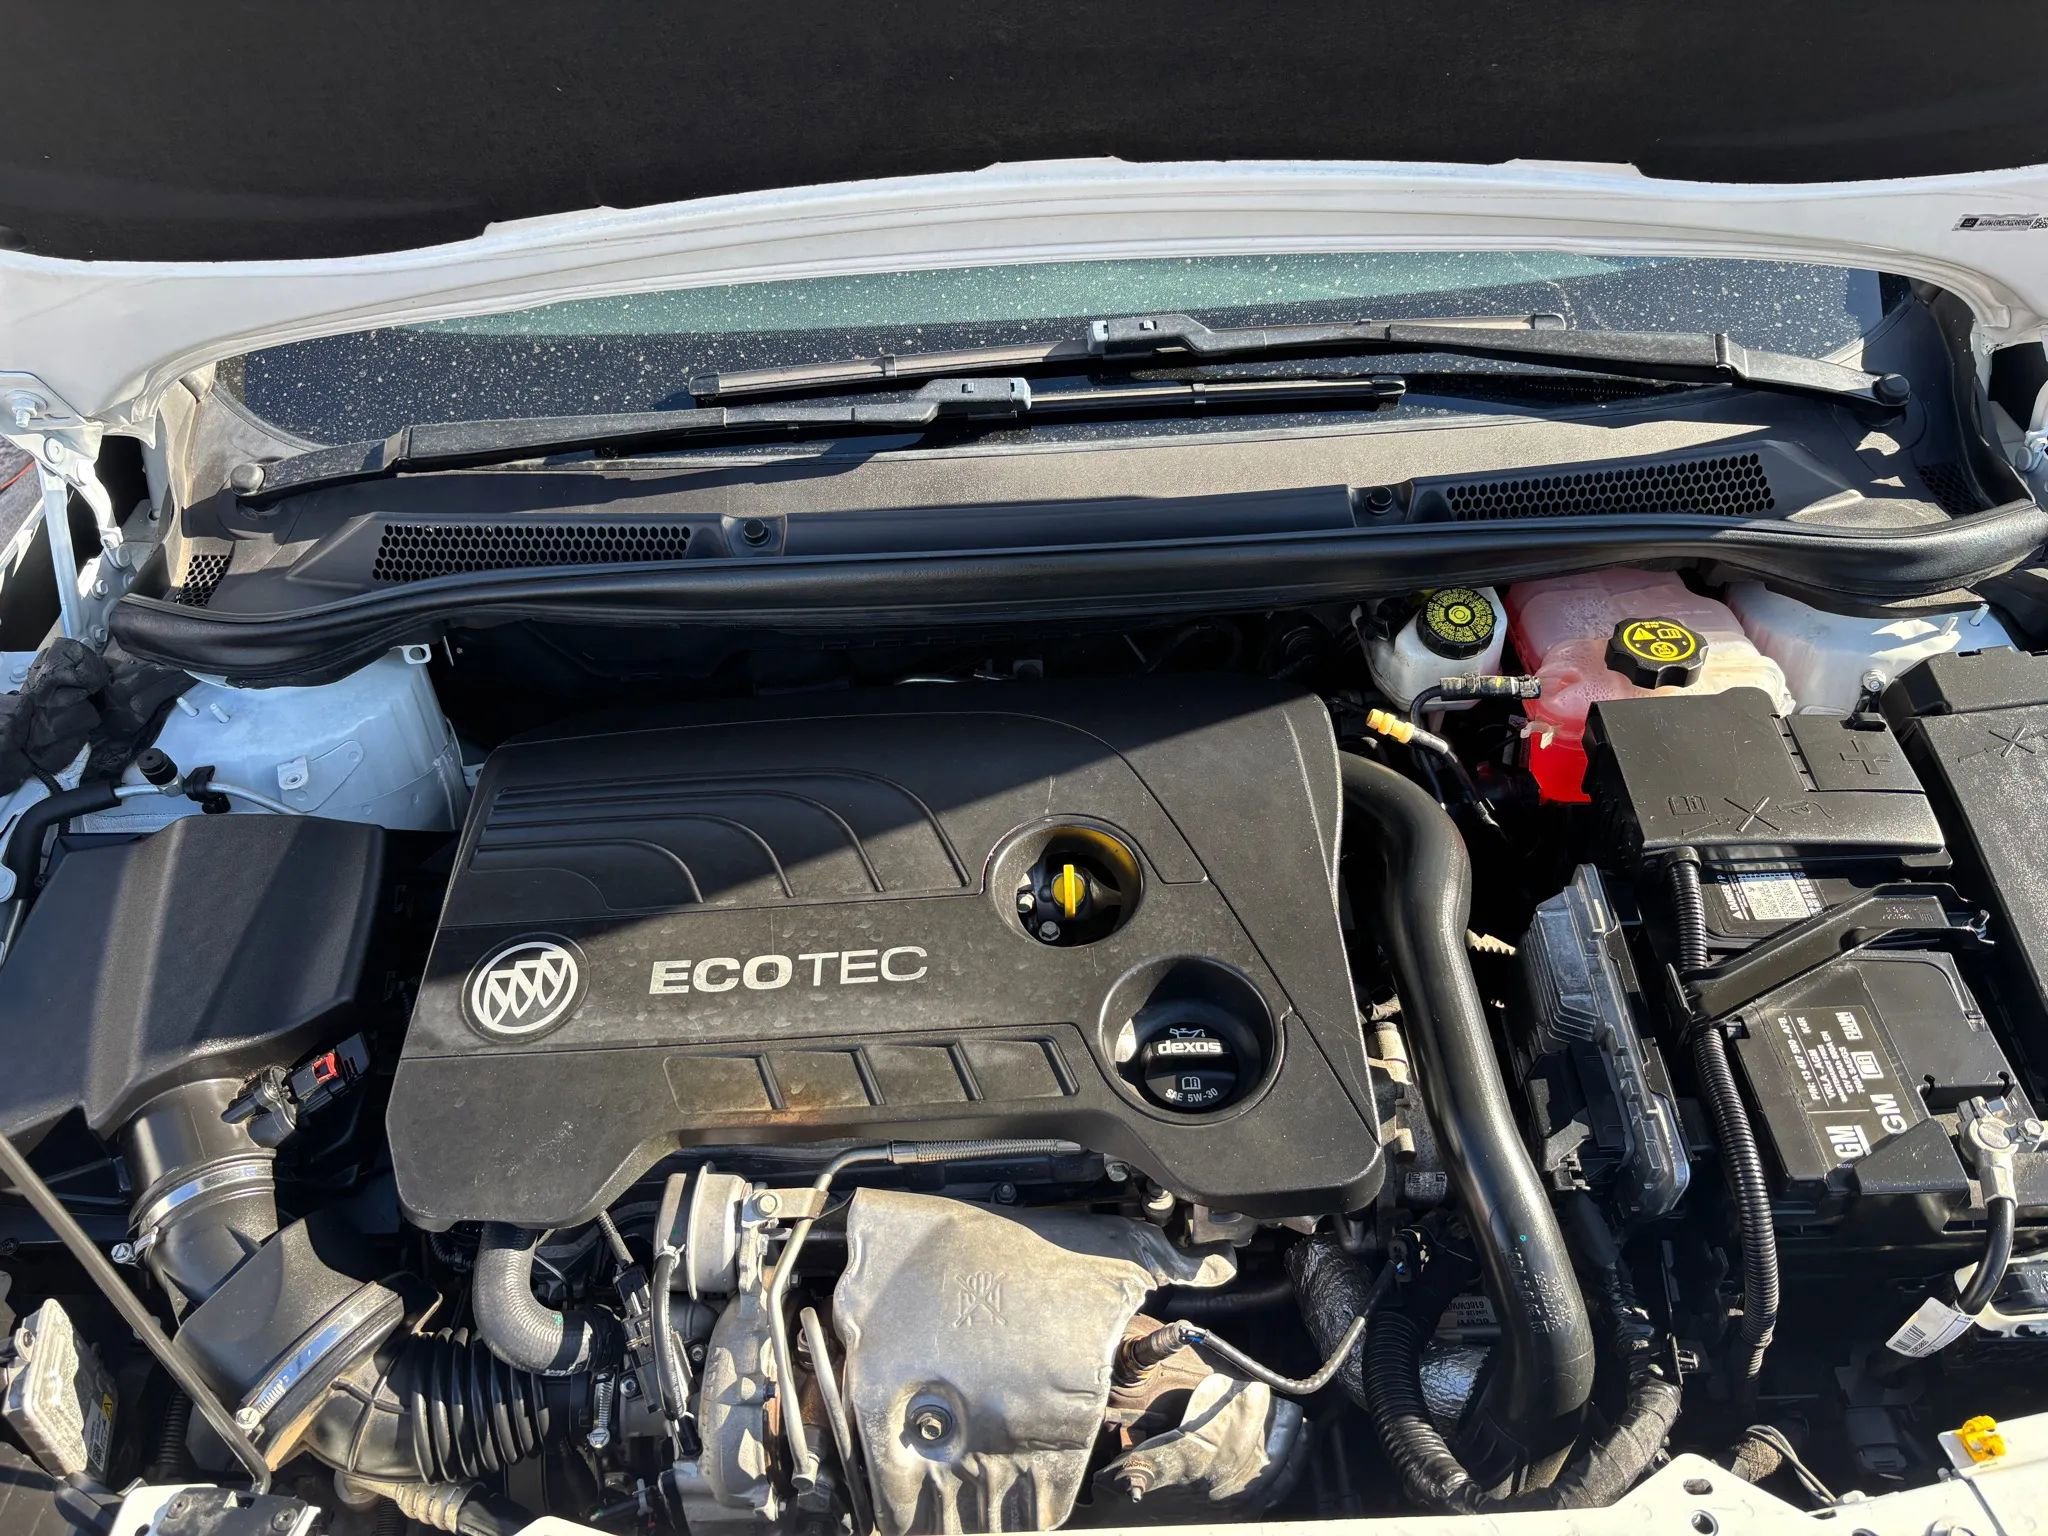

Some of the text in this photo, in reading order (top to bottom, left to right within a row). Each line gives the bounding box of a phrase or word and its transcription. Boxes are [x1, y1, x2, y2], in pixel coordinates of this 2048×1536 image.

[649, 945, 929, 995] ECOTEC
[1157, 1040, 1223, 1054] dexos
[1165, 1088, 1218, 1103] SAE 5W-30
[1869, 1093, 1908, 1134] GM
[1825, 1125, 1864, 1158] GM
